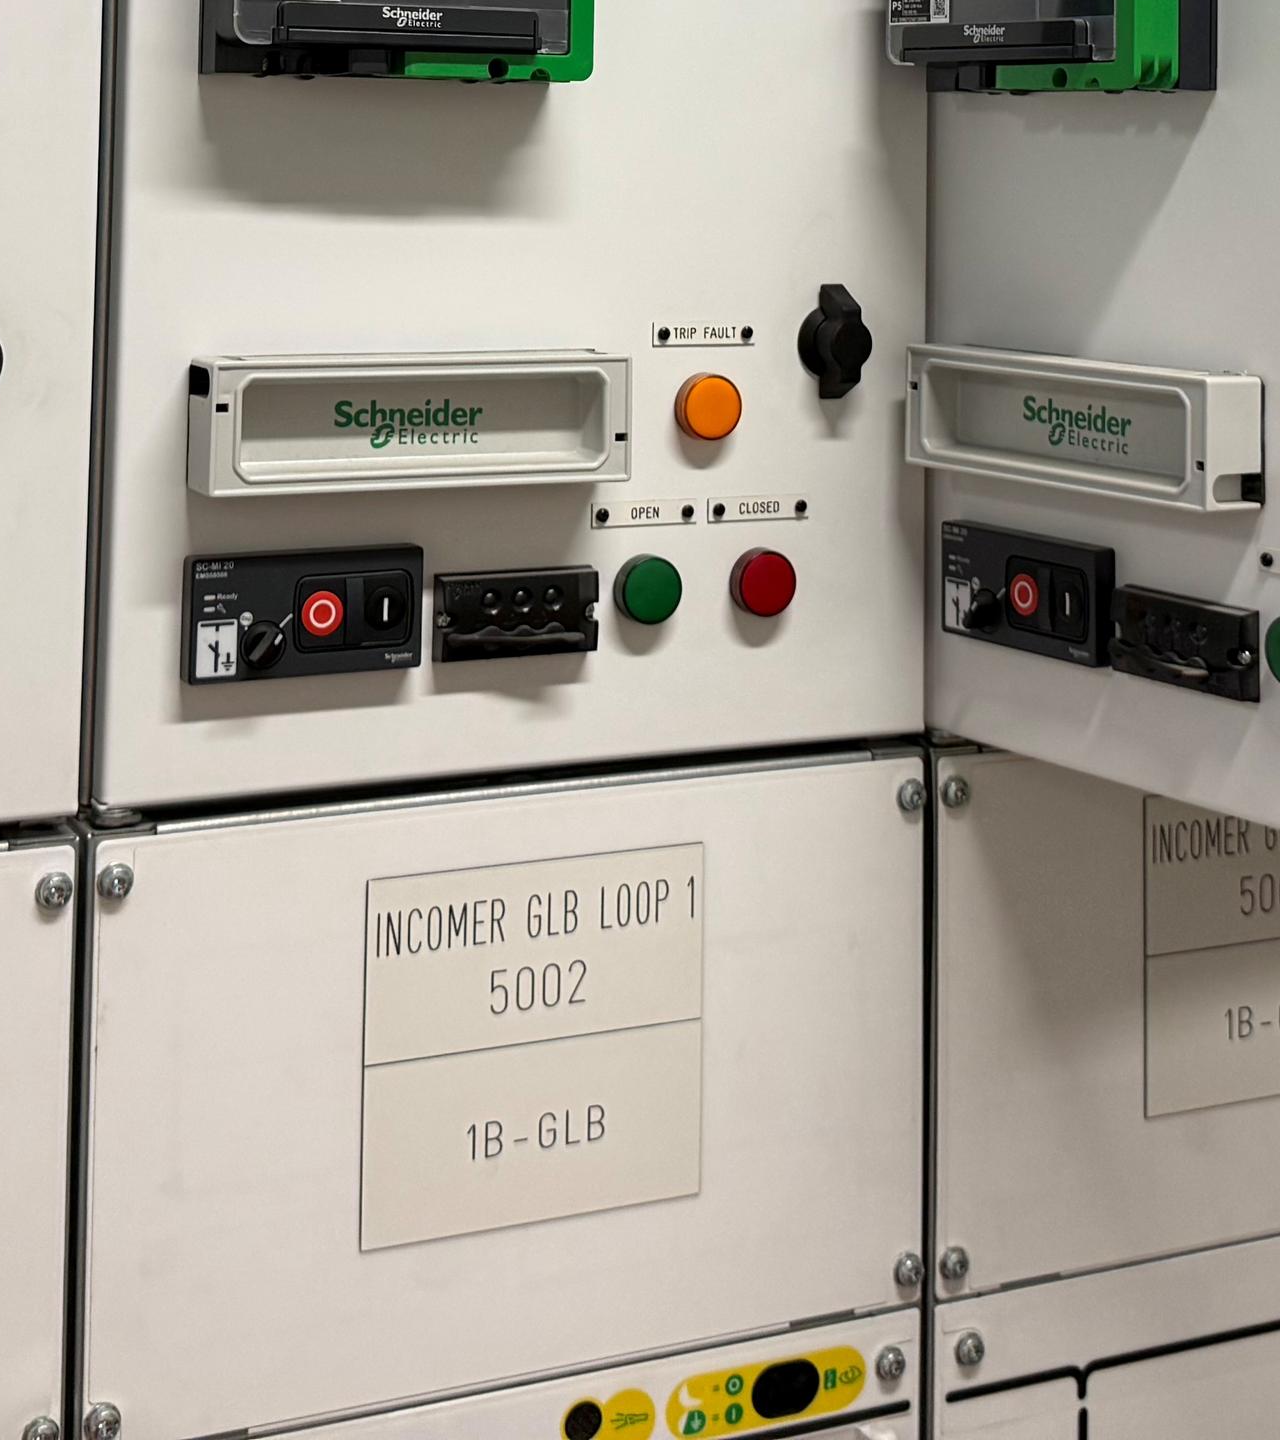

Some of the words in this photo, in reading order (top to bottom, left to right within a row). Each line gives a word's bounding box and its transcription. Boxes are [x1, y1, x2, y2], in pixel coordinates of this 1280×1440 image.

[892, 0, 902, 11] P5
[382, 6, 443, 21] Schneider
[408, 19, 442, 29] Electric
[963, 24, 1006, 36] Schneider
[673, 327, 697, 340] TRIP
[703, 326, 737, 340] FAULT
[334, 399, 483, 428] Schneider
[1023, 395, 1132, 437] Schneider
[398, 429, 479, 445] Electric
[1068, 429, 1129, 455] Electric
[631, 506, 660, 520] OPEN
[739, 501, 780, 515] CLOSED
[1151, 815, 1251, 864] INCOMER
[376, 898, 506, 958] INCOMER
[527, 889, 579, 939] GLB
[600, 879, 670, 930] LOOP
[687, 875, 696, 919] 1
[490, 959, 587, 1015] 5002
